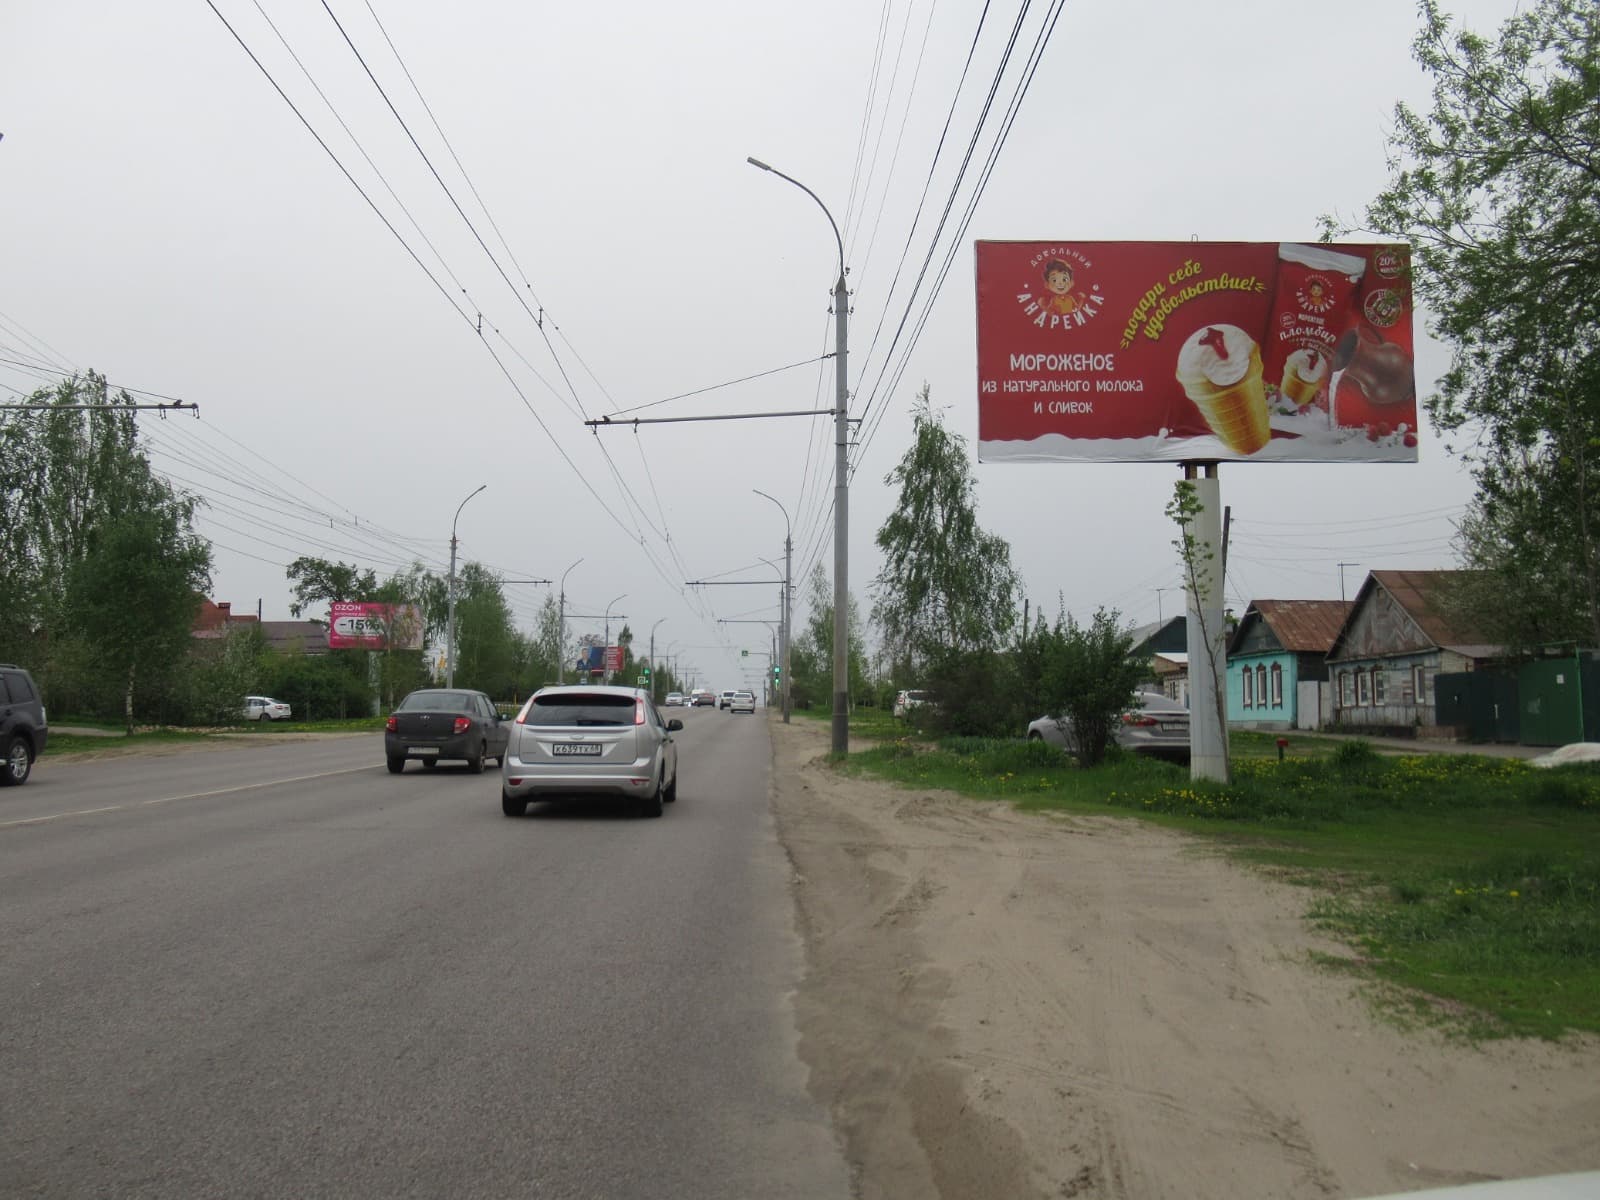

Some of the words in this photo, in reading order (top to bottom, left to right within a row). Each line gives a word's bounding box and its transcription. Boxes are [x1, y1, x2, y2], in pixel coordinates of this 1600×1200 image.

[1123, 282, 1166, 342] подари
[1168, 259, 1202, 285] себе
[1143, 272, 1256, 341] удовольствие!
[1009, 353, 1115, 372] МОРОЖЕНОЕ
[982, 380, 998, 393] ИЗ
[1033, 401, 1043, 414] И
[1048, 401, 1094, 414] СЛИВОК
